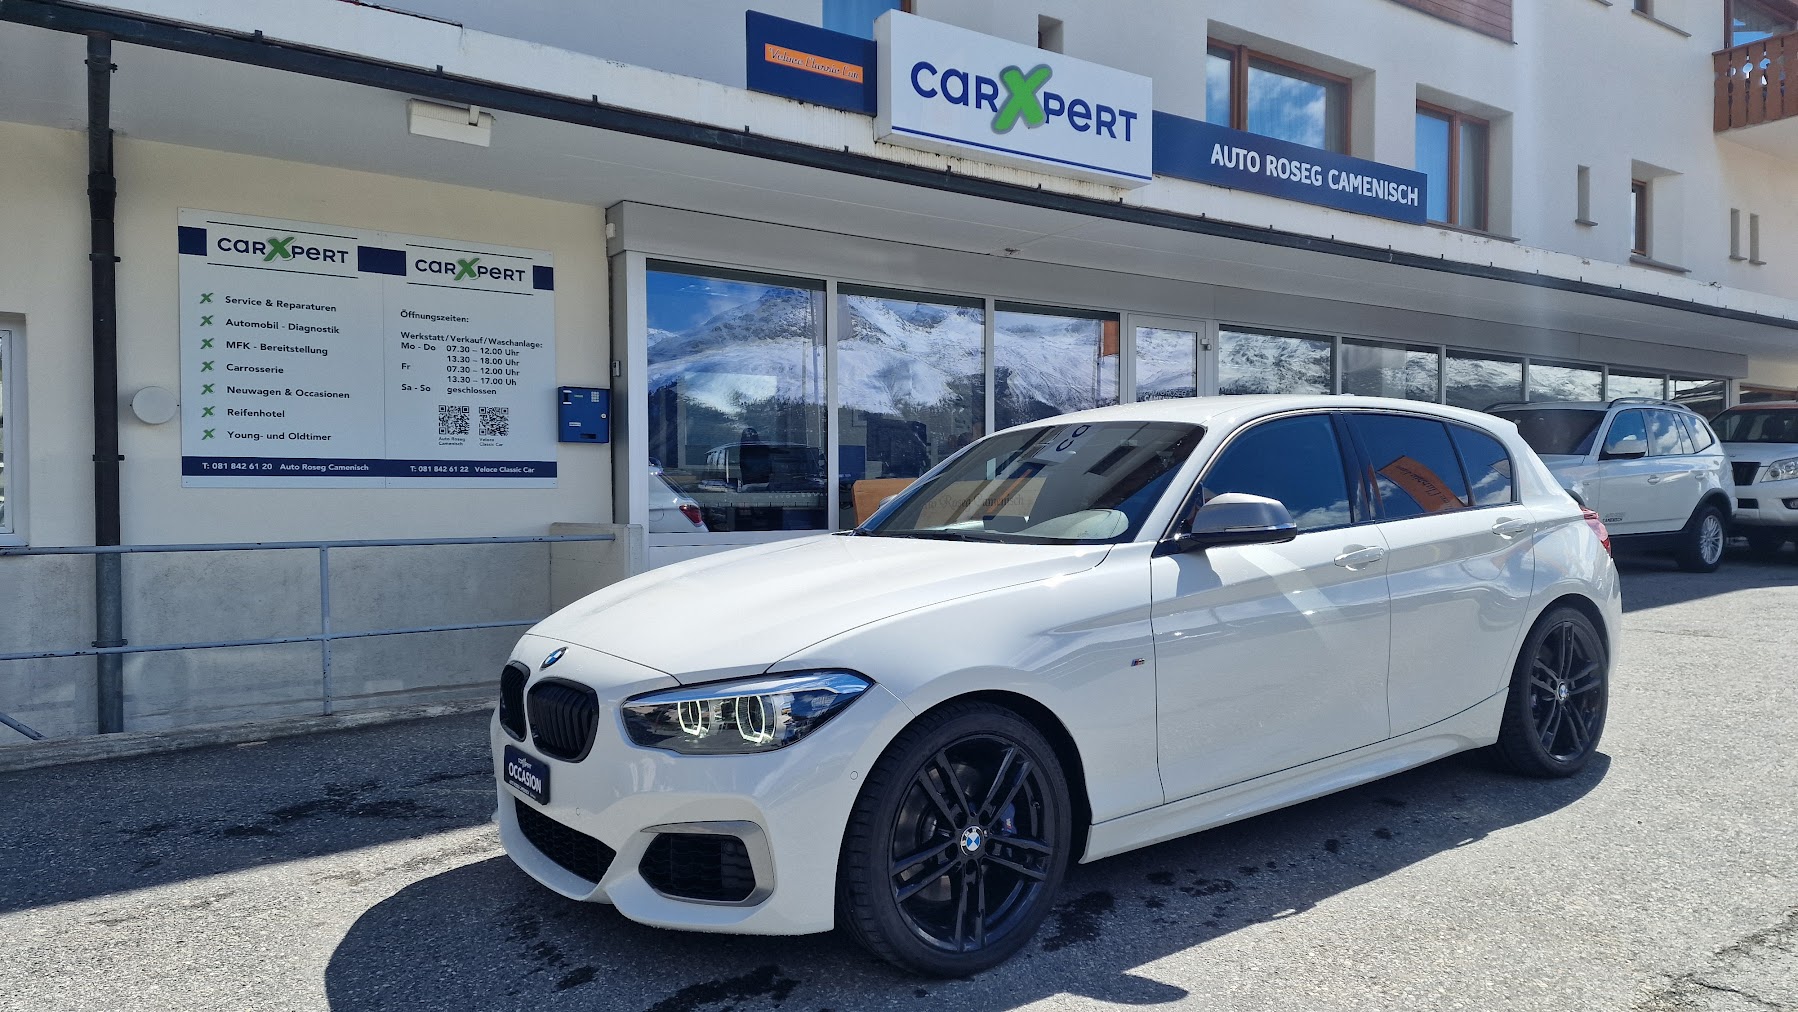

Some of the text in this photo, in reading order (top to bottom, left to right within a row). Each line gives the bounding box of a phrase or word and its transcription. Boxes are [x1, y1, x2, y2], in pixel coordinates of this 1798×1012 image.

[1211, 143, 1419, 206] AUTO ROSEG CAMENISCH
[225, 296, 262, 306] Service
[277, 300, 336, 312] Reparaturen
[401, 310, 469, 323] Öffnungszeiten:
[226, 319, 279, 329] Automobil
[288, 323, 339, 335] Diagnostik
[226, 342, 250, 350] MFK
[260, 343, 328, 356] Bereitstellung
[401, 342, 415, 350] Mo
[447, 345, 470, 353] 07.30
[481, 347, 502, 355] 12.00
[505, 349, 519, 357] Uhr
[481, 357, 502, 365] 18.00
[226, 364, 284, 374] Carrosserie
[447, 365, 470, 373] 07.30
[447, 376, 470, 384] 13.30
[481, 377, 502, 385] 17.00
[227, 386, 282, 396] Neuwagen
[296, 389, 350, 399] Occasionen
[447, 387, 496, 395] geschlossen
[227, 409, 285, 417] Reifenhotel
[227, 431, 332, 441] Young- und Oldtimer
[302, 464, 326, 472] Roseg
[475, 466, 497, 474] Veloce
[508, 762, 541, 793] OCCASION
